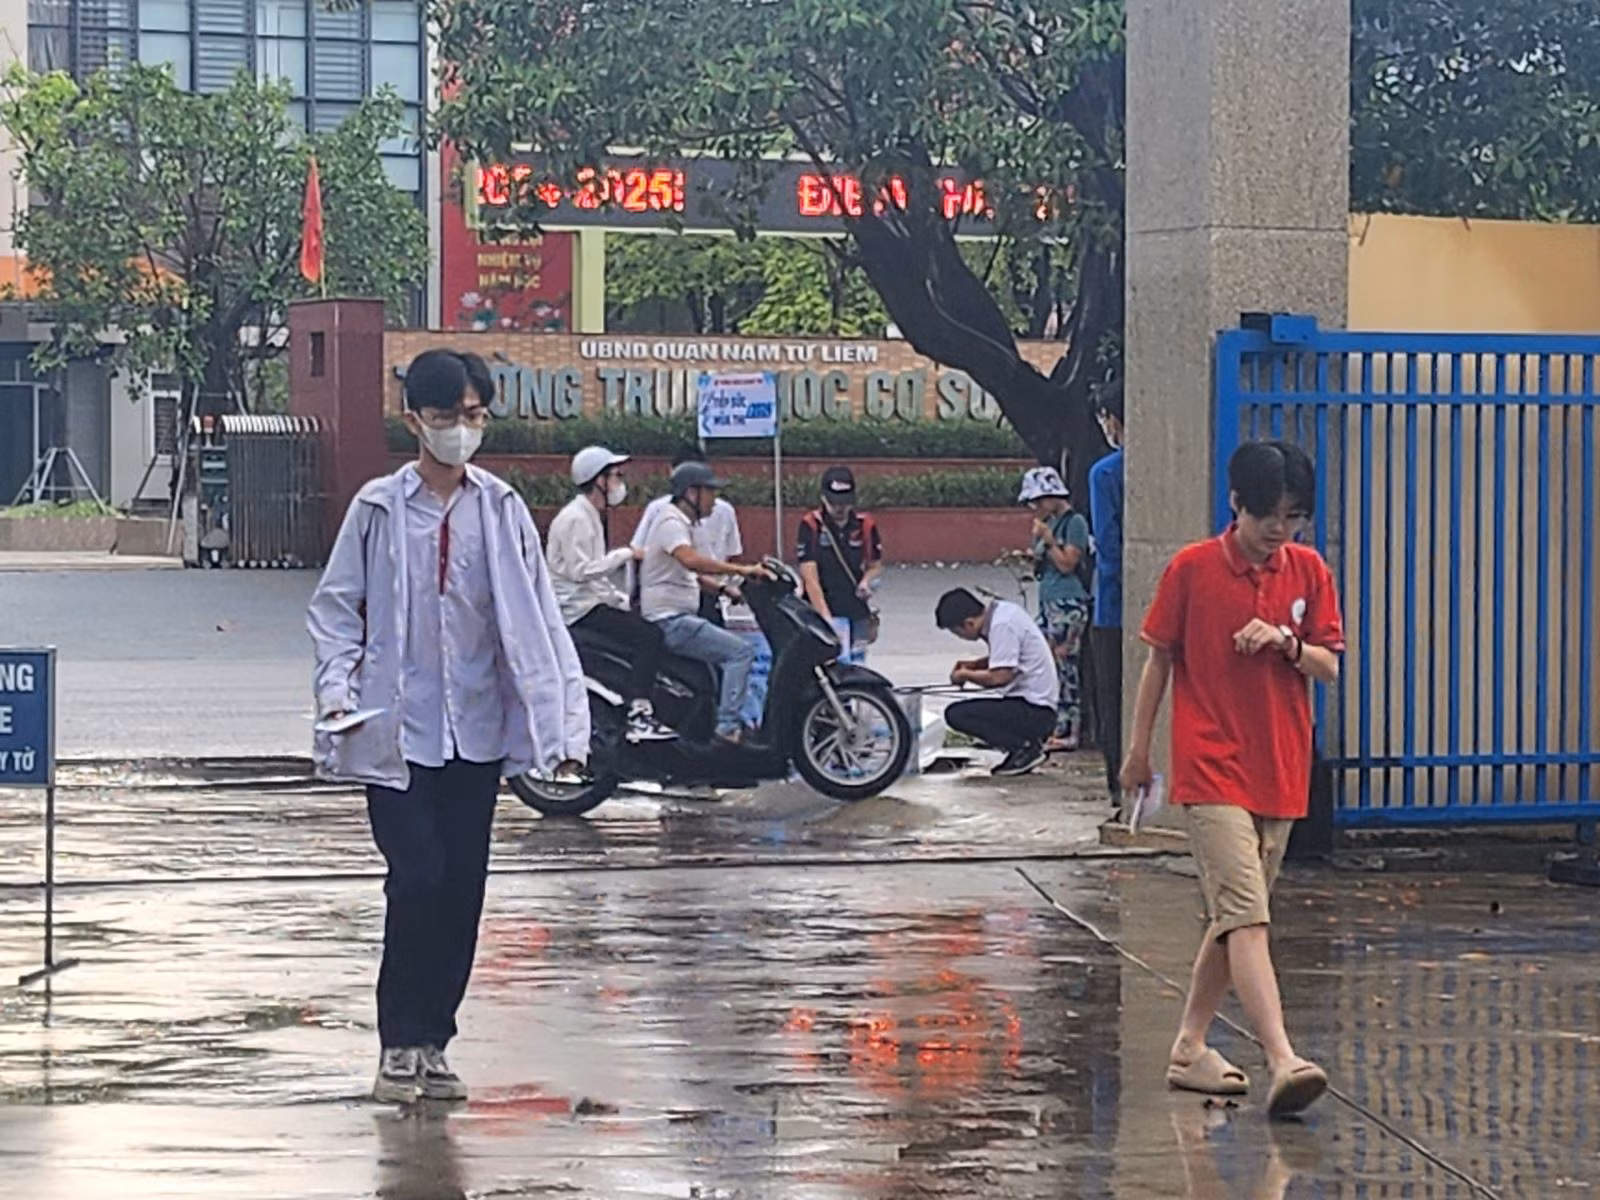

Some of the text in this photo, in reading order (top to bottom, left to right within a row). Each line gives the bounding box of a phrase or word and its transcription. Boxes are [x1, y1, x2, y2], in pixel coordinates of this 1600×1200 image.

[580, 341, 648, 360] UBND
[721, 343, 780, 361] NAM
[596, 365, 700, 421] TRU
[0, 663, 34, 692] NG
[12, 746, 36, 772] TỜ
